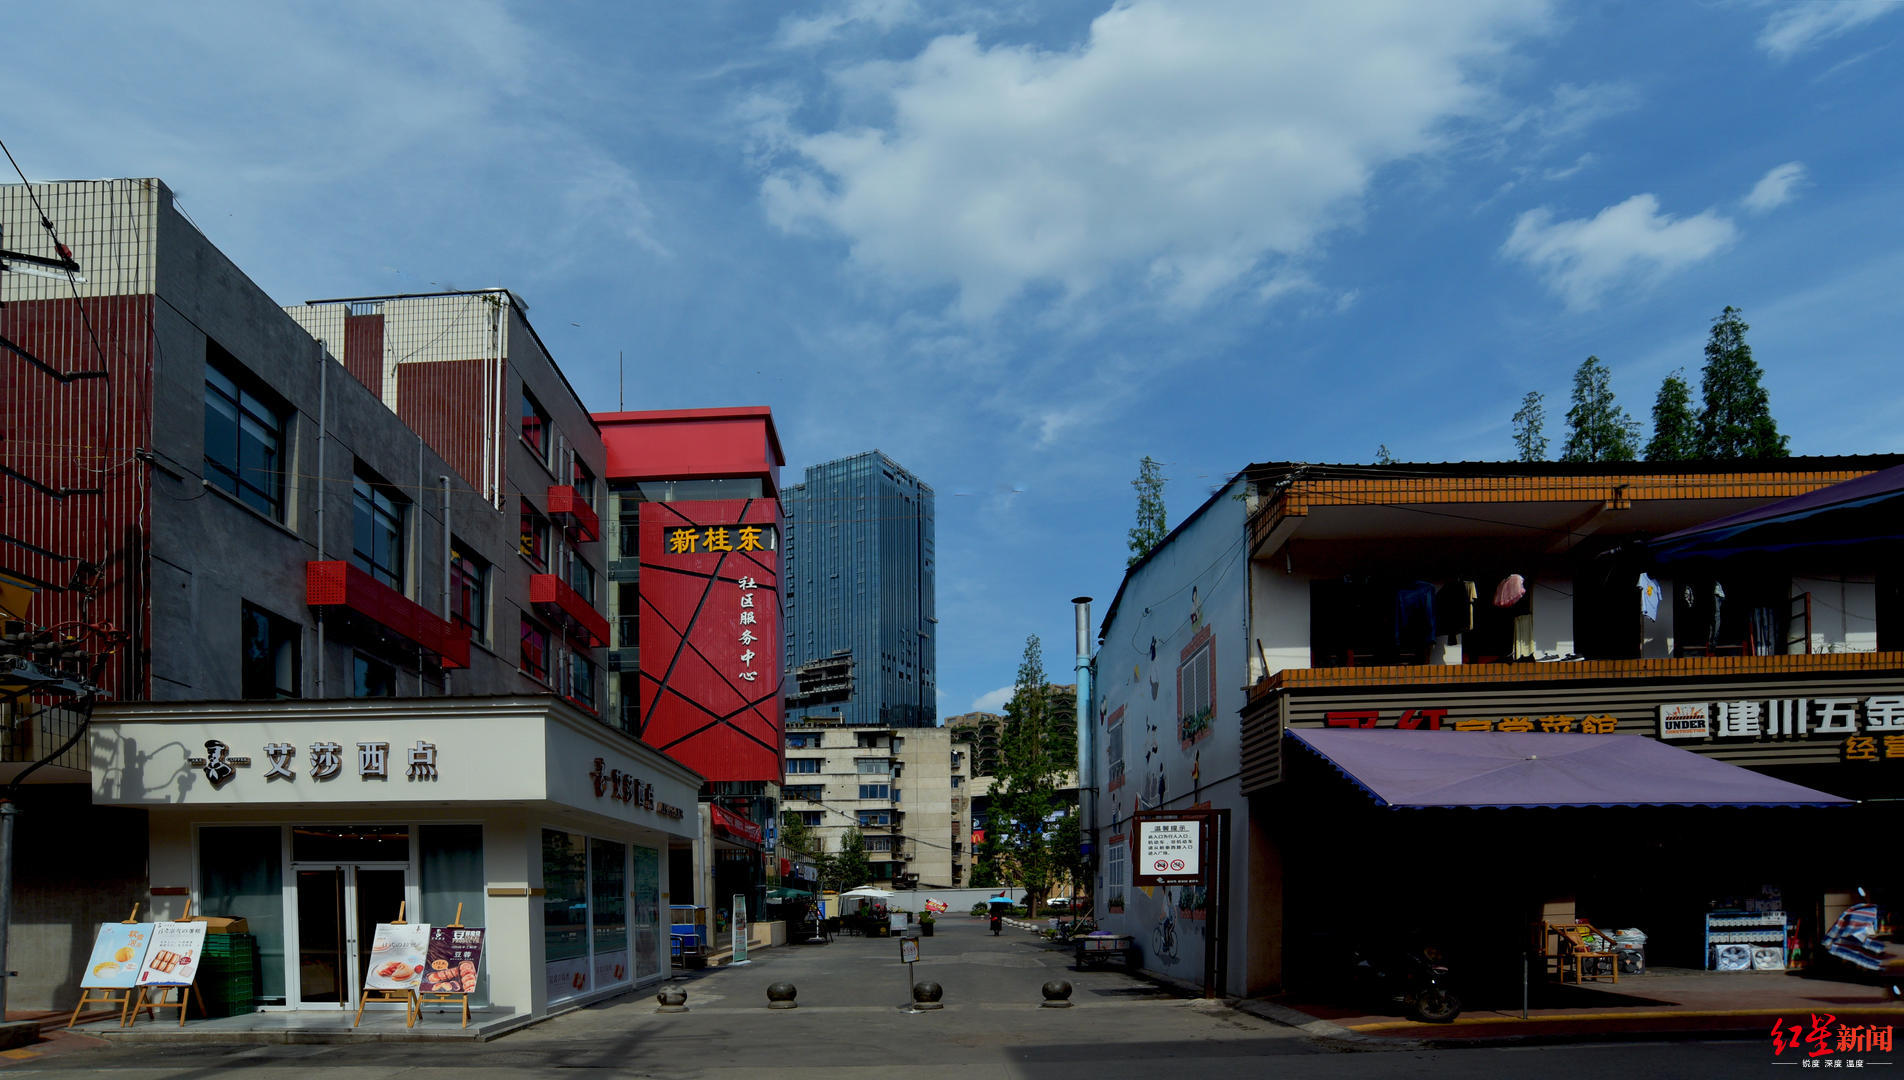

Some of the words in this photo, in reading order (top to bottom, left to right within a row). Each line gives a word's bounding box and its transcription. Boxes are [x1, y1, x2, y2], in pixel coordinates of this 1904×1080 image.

[669, 525, 765, 553] 新桂东
[738, 576, 758, 682] 社区服务中心
[1665, 719, 1706, 730] UNDER
[1716, 695, 1904, 737] 建川五金
[263, 740, 438, 782] 艾莎西点
